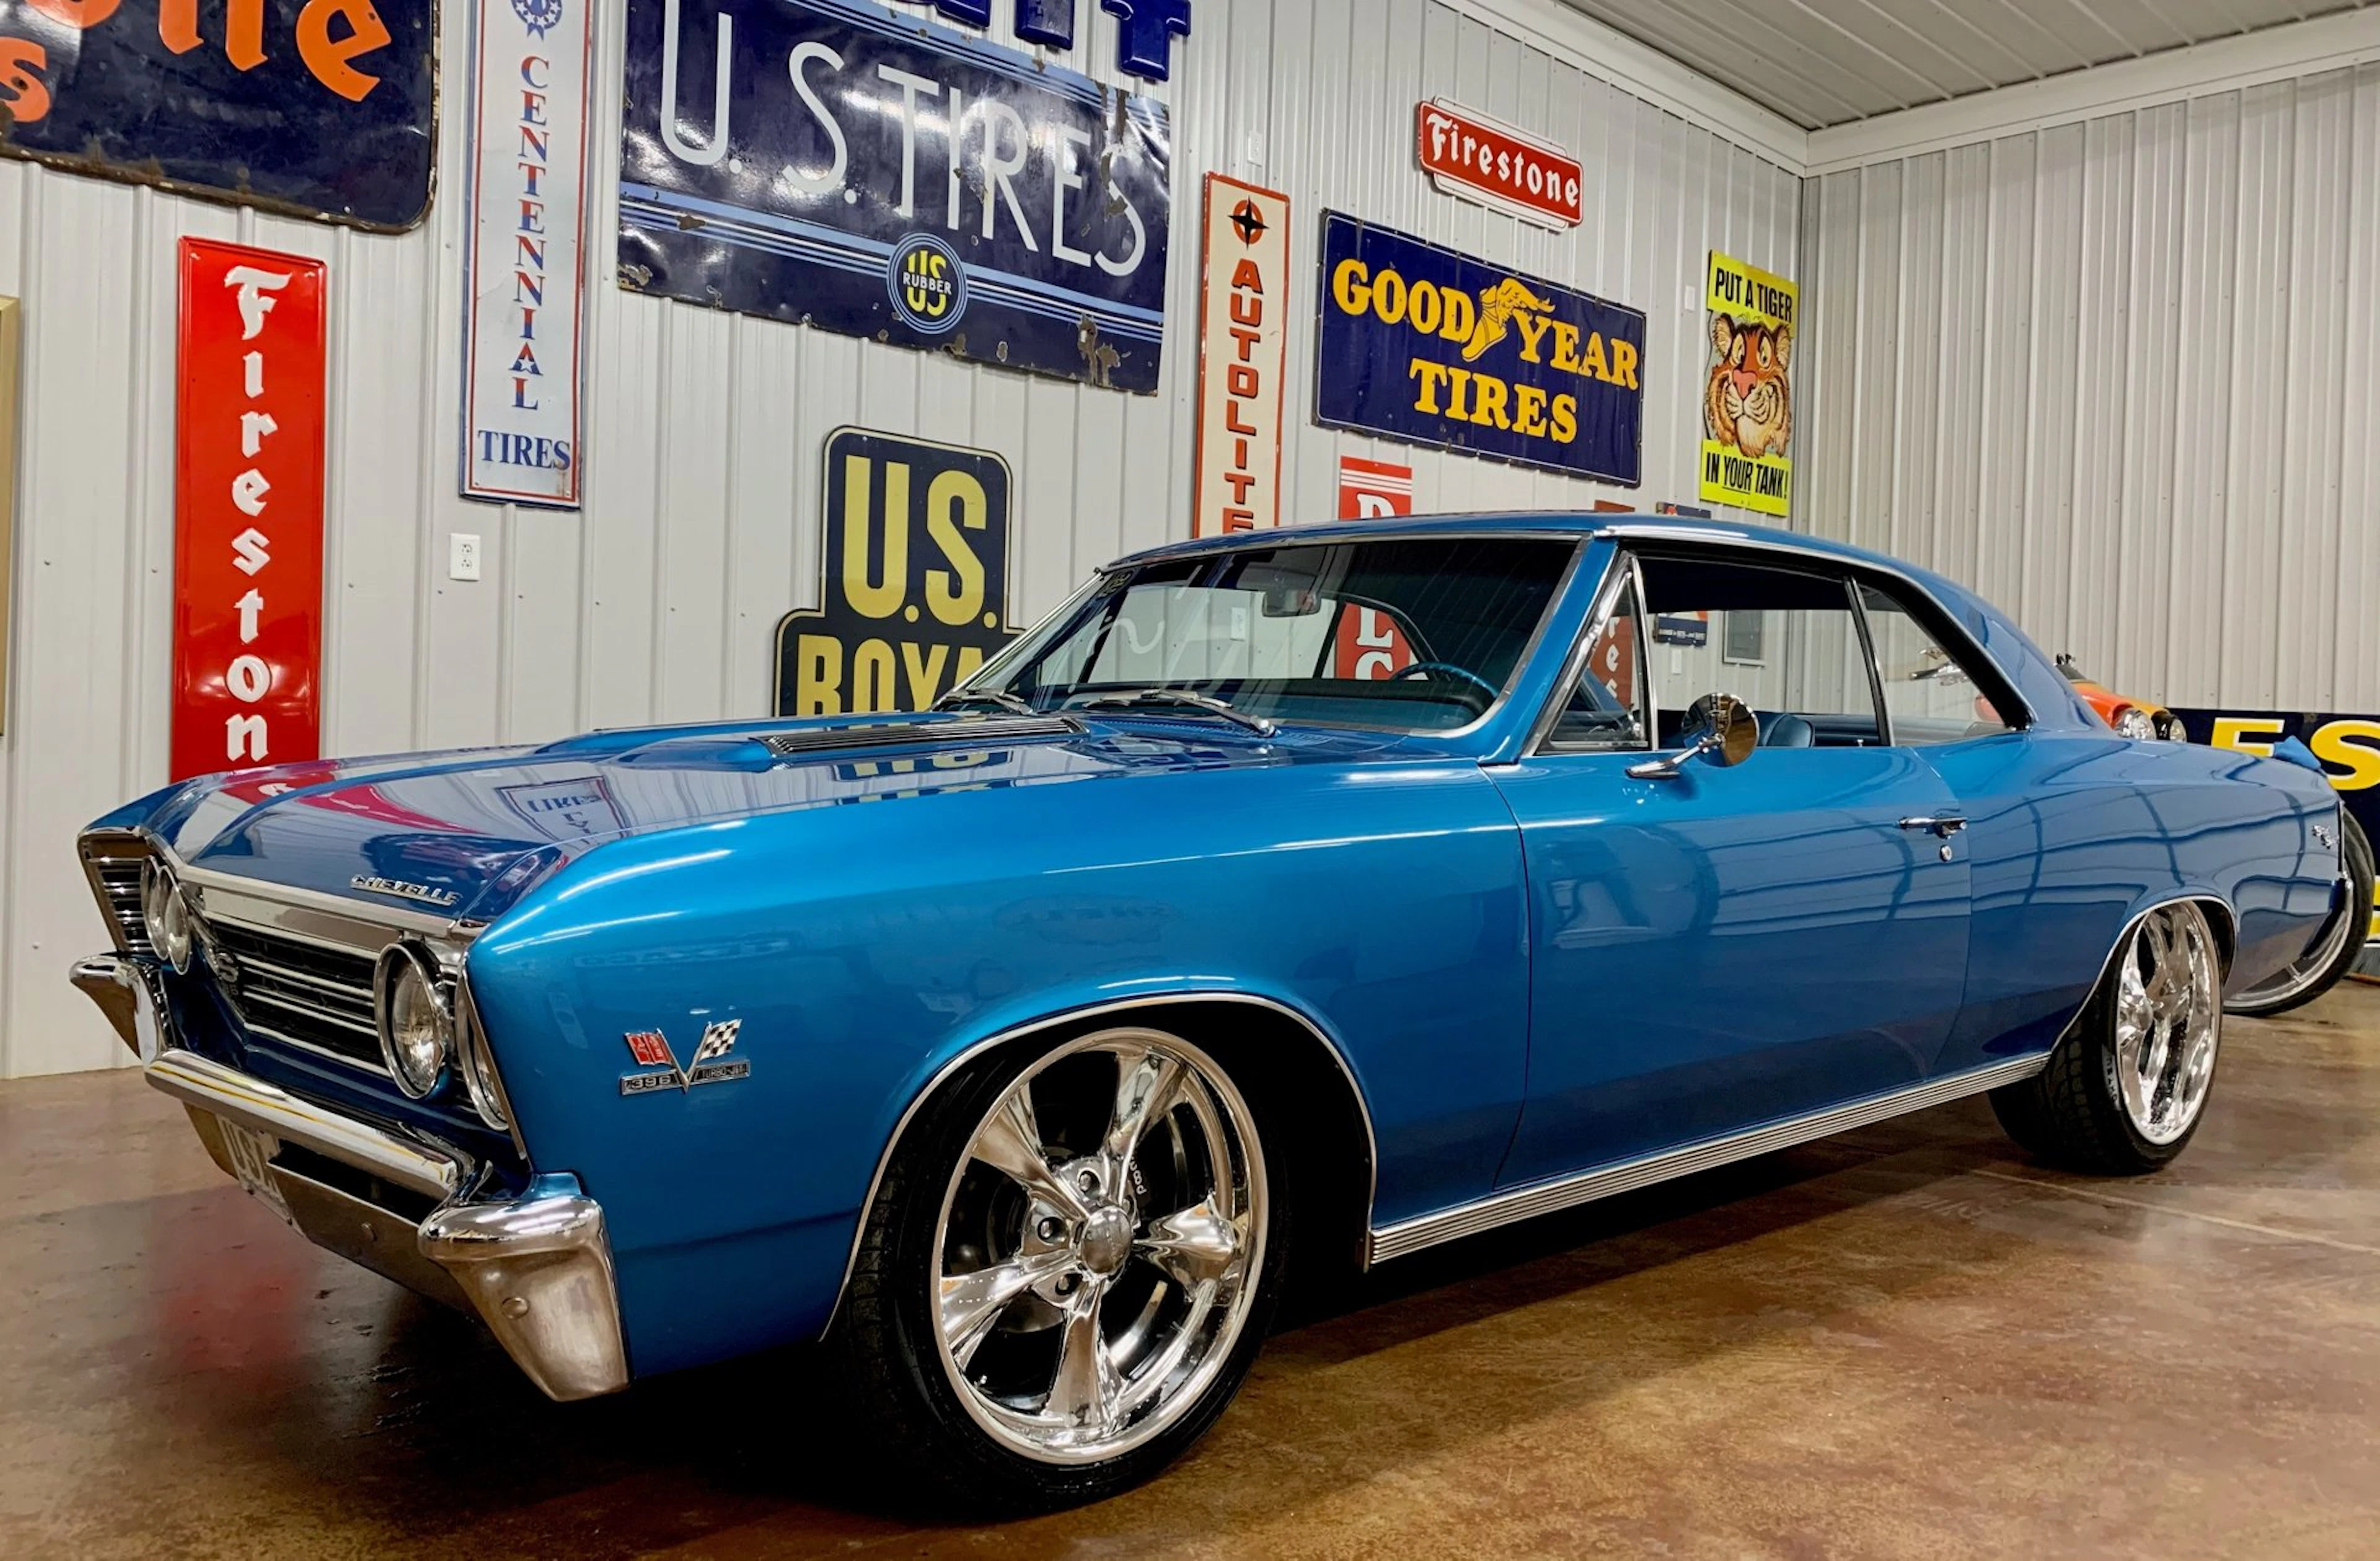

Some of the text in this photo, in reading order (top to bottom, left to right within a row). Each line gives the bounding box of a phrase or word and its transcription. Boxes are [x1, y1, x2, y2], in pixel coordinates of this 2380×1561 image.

[877, 63, 1147, 277] TIRES
[1426, 112, 1579, 208] Firestone
[508, 55, 550, 412] CENTENNIAL
[902, 272, 953, 296] RUBBER
[1714, 267, 1793, 324] PUT A TIGER
[1220, 257, 1262, 534] AUTOLITE
[1408, 357, 1579, 444] TIRES
[478, 430, 571, 471] TIRES
[1706, 452, 1789, 500] IN YOUR TANK!
[224, 265, 291, 763] Fireston
[842, 454, 998, 629] U.S.
[350, 874, 464, 906] CHEVELLE
[631, 1075, 672, 1090] 396
